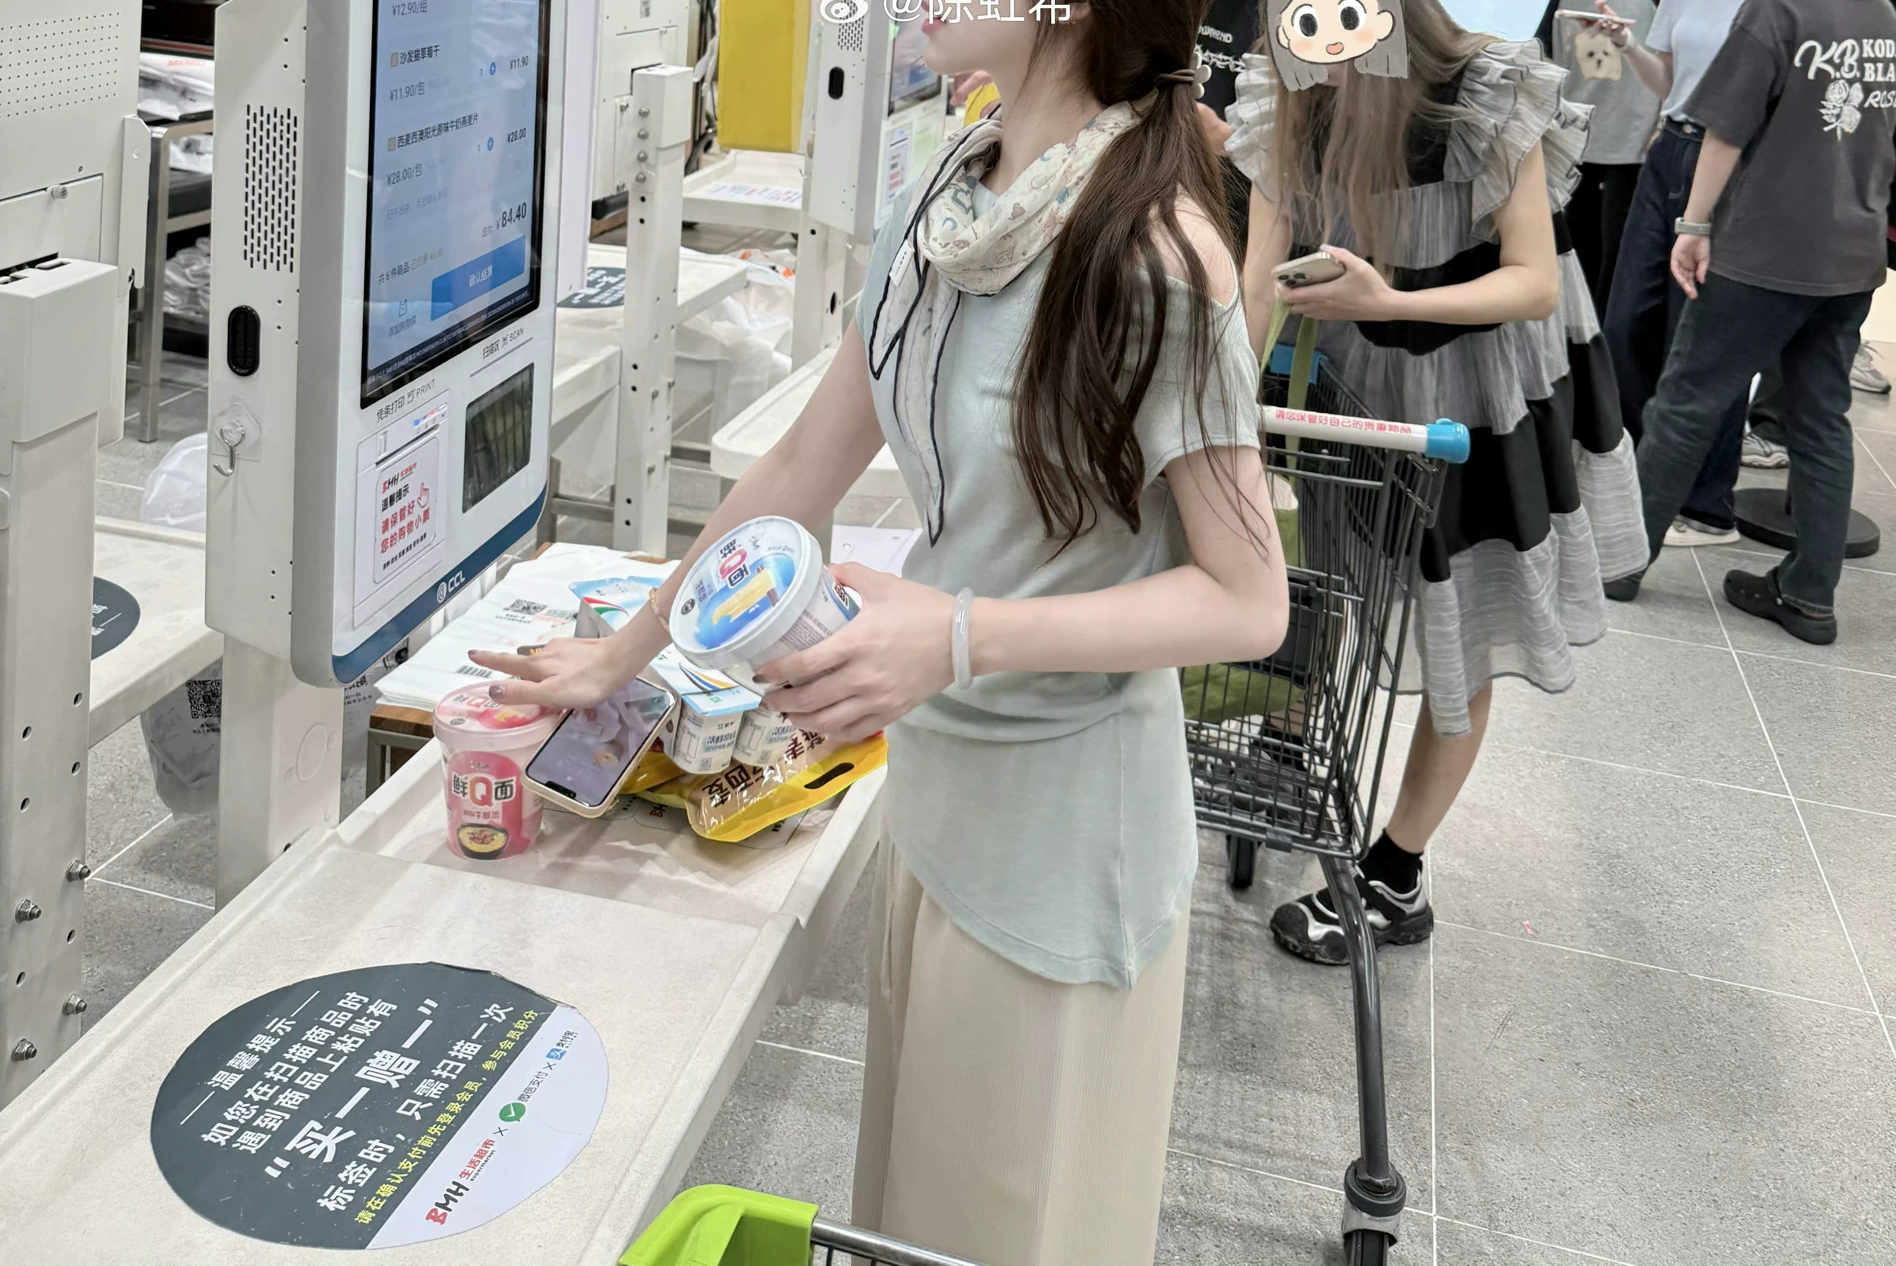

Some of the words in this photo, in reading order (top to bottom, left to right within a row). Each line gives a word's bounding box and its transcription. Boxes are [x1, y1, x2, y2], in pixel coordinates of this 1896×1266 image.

[1861, 38, 1896, 58] KOD
[509, 327, 524, 342] SCAN
[416, 378, 436, 397] PRINT
[381, 500, 415, 534] 请保管好
[447, 570, 466, 593] CCL
[452, 773, 516, 807] 鲜Q面
[201, 991, 370, 1146] 如您在扫描商品时
[207, 1017, 296, 1091] 温馨提示
[232, 999, 397, 1154] 遇到商品上粘贴有
[354, 1009, 538, 1225] 请在确认支付前先登录会员，参与会员积分
[425, 1180, 470, 1226] BMH
[459, 1138, 496, 1180] 生活超市
[517, 1070, 549, 1102] 微信支付
